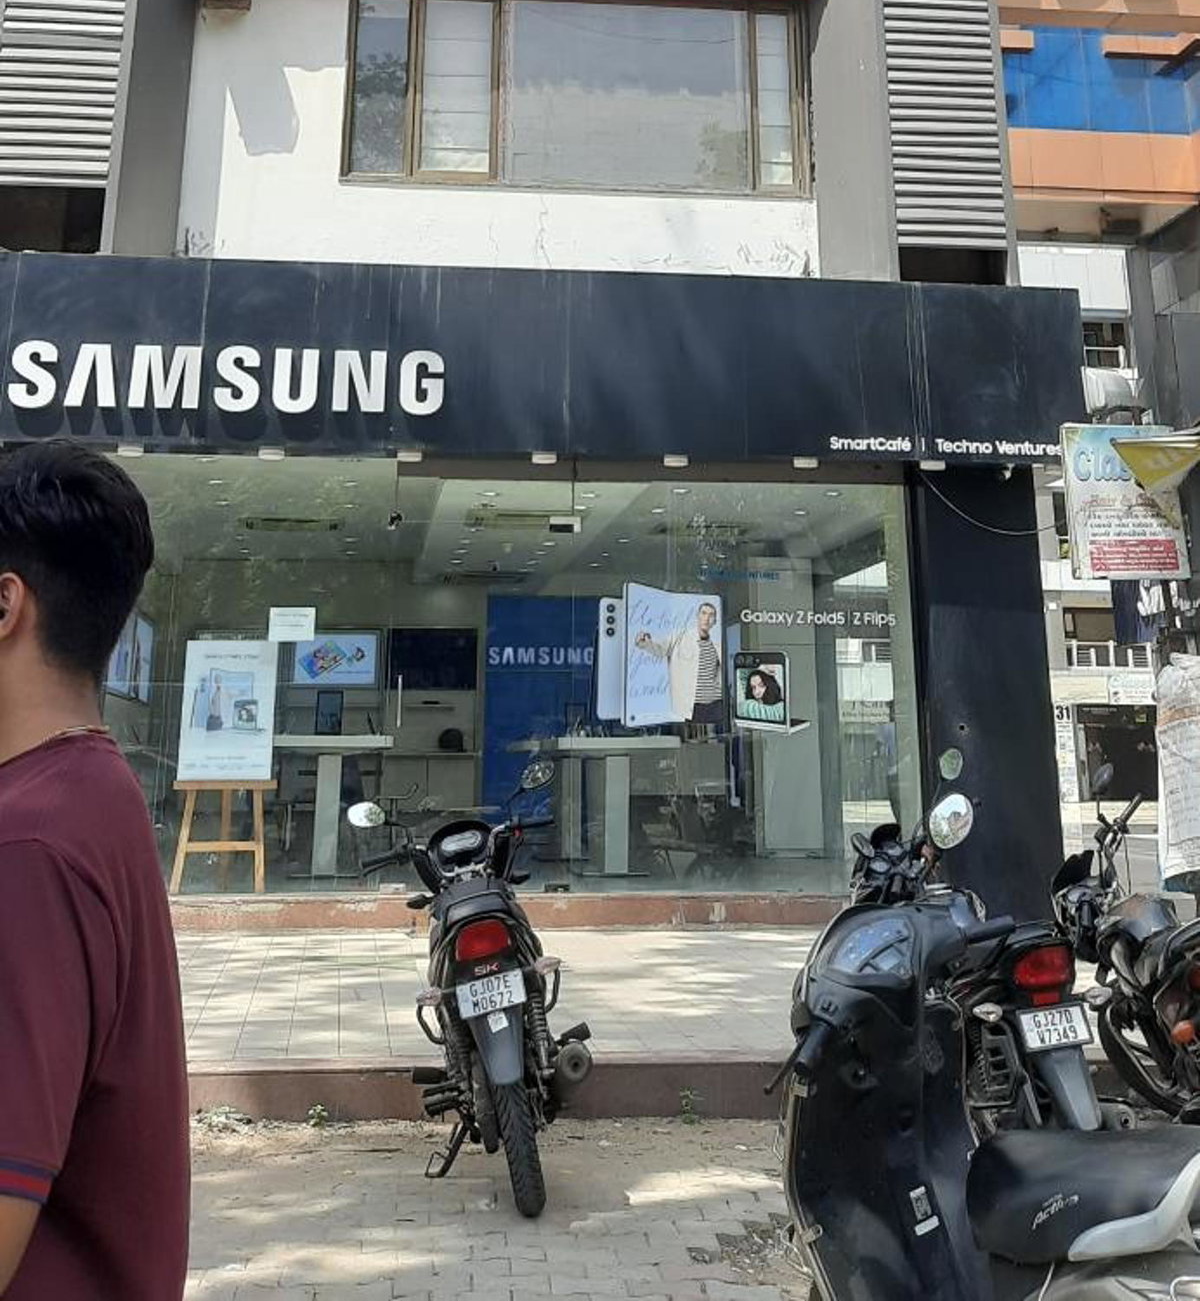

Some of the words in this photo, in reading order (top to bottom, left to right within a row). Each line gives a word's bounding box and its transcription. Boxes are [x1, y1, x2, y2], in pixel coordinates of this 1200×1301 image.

[7, 339, 446, 416] SAMSUNG
[829, 436, 912, 452] SmartCafé
[935, 438, 993, 455] Techno
[740, 609, 793, 627] Galaxy
[807, 611, 846, 625] Fold5
[488, 646, 594, 666] SAMSUNG
[1055, 705, 1071, 721] 31
[469, 974, 511, 998] GJ07E
[472, 990, 514, 1014] M0672
